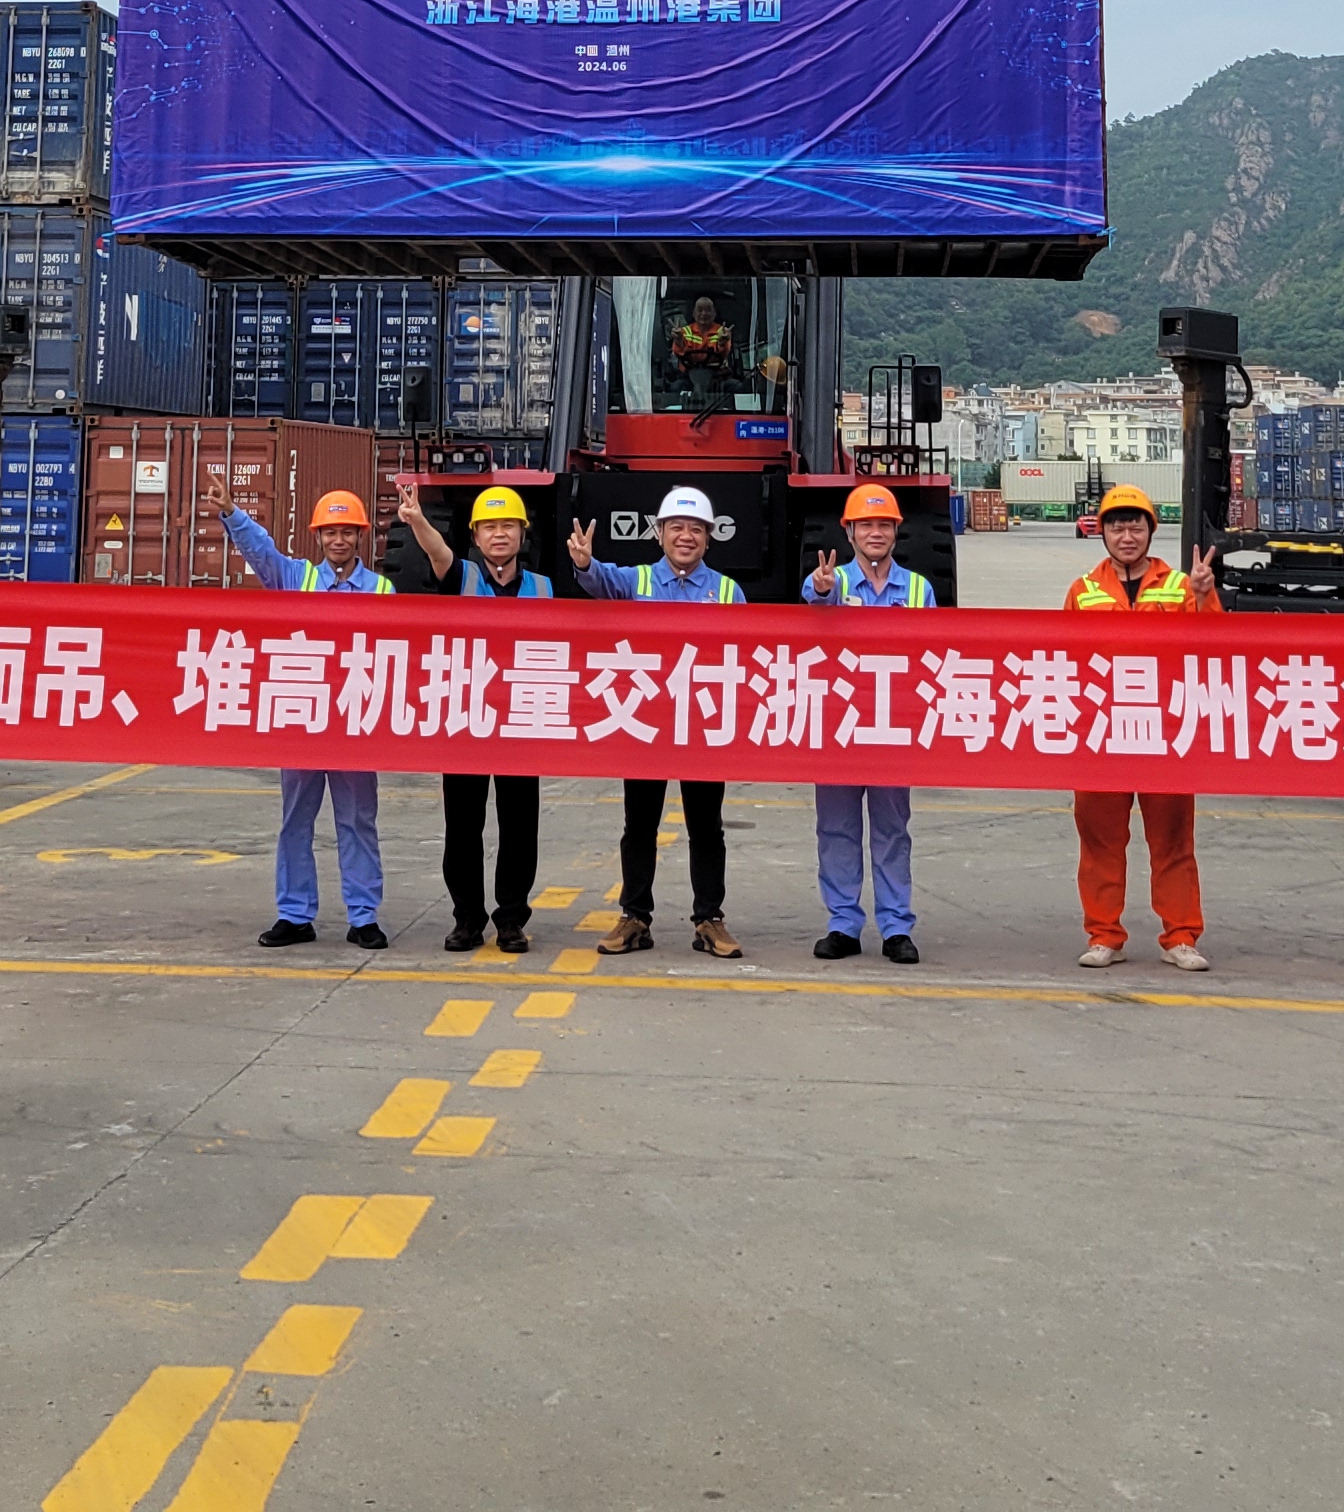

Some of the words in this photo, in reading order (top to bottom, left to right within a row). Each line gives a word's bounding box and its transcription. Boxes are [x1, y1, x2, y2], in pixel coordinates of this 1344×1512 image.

[22, 48, 41, 57] NBYU
[48, 48, 75, 57] 268098
[48, 59, 65, 69] 22G1
[577, 62, 627, 71] 2024.06
[14, 89, 31, 99] TARE
[15, 253, 33, 263] NBYU
[42, 254, 69, 263] 304513
[42, 266, 59, 275] 22G1
[8, 463, 27, 473] NBYU
[35, 463, 62, 473] 002793
[235, 465, 261, 474] 126007
[1020, 469, 1044, 477] OOCL
[35, 476, 53, 486] 22B0
[233, 476, 251, 485] 22G1
[638, 514, 737, 542] XG
